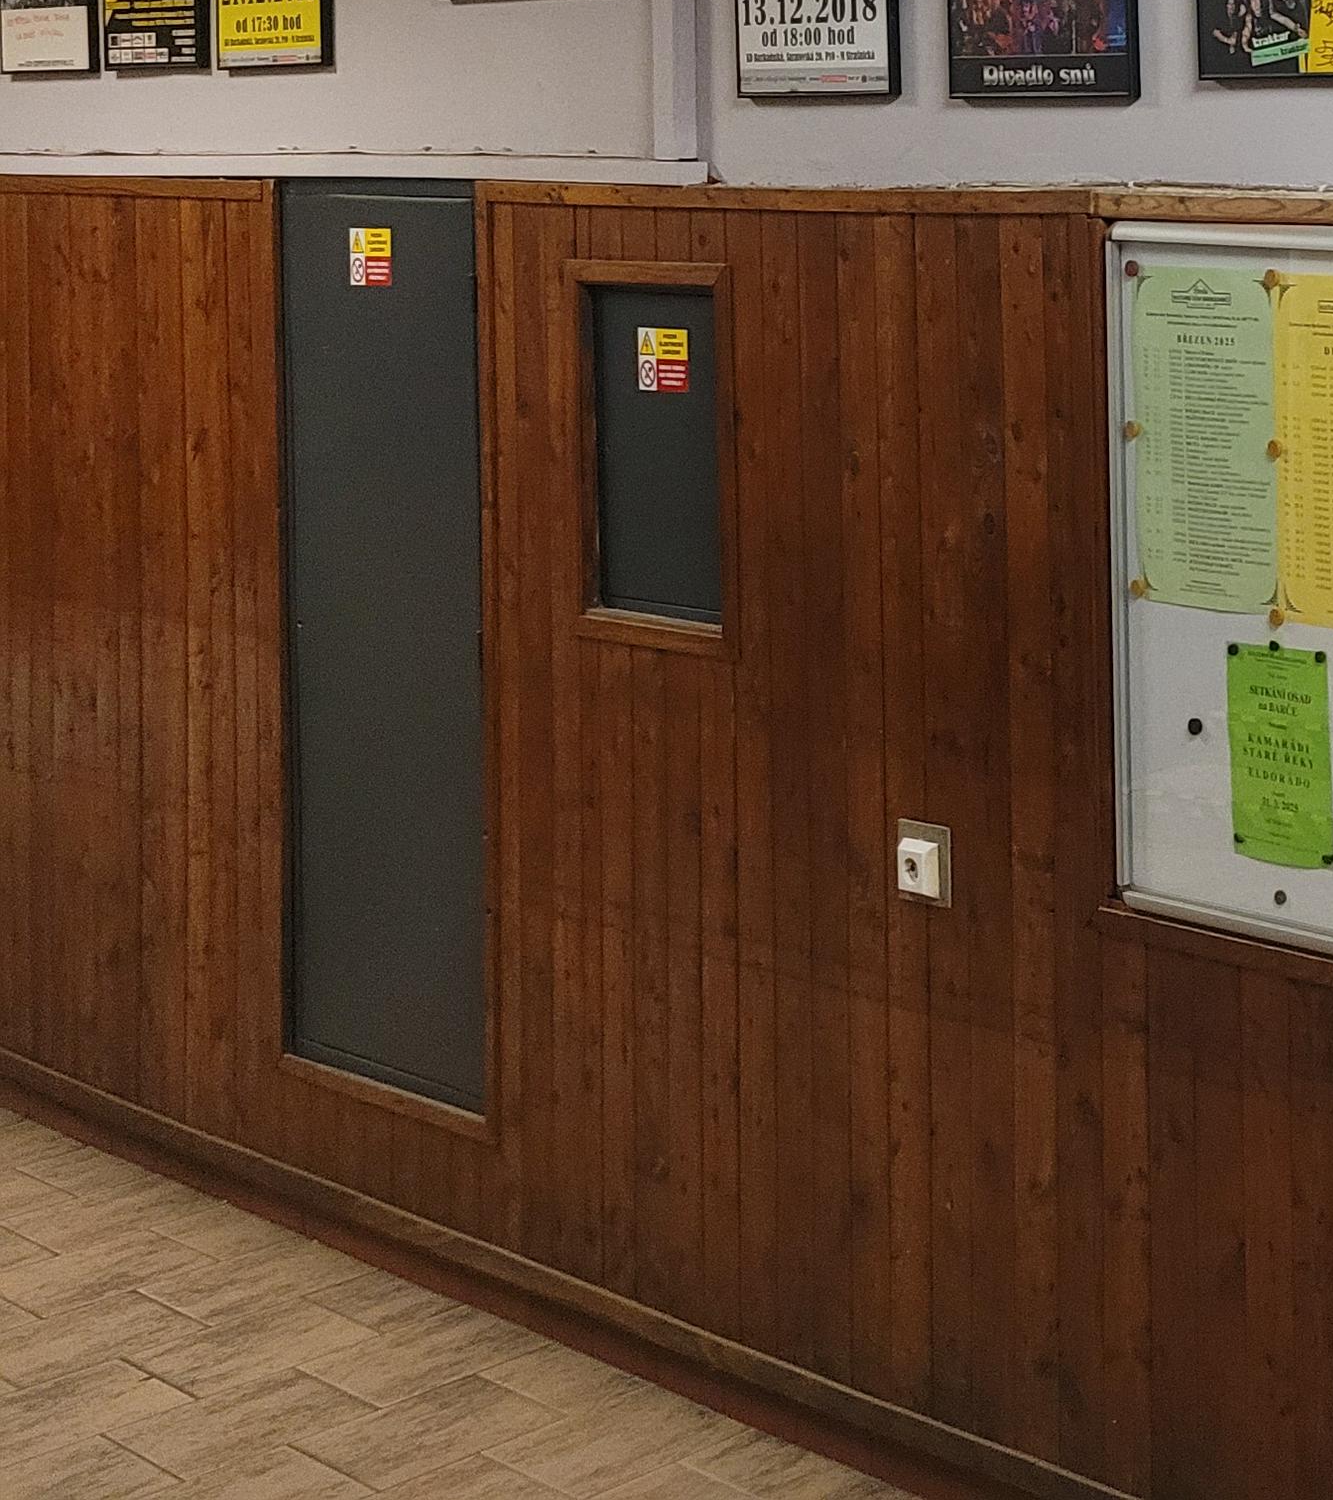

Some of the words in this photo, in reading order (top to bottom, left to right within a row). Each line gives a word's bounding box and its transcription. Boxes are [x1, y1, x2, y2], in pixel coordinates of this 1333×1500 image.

[236, 15, 248, 33] od
[251, 15, 279, 33] 17:30
[762, 28, 777, 47] od
[783, 27, 821, 46] 18:00
[827, 26, 855, 45] hod
